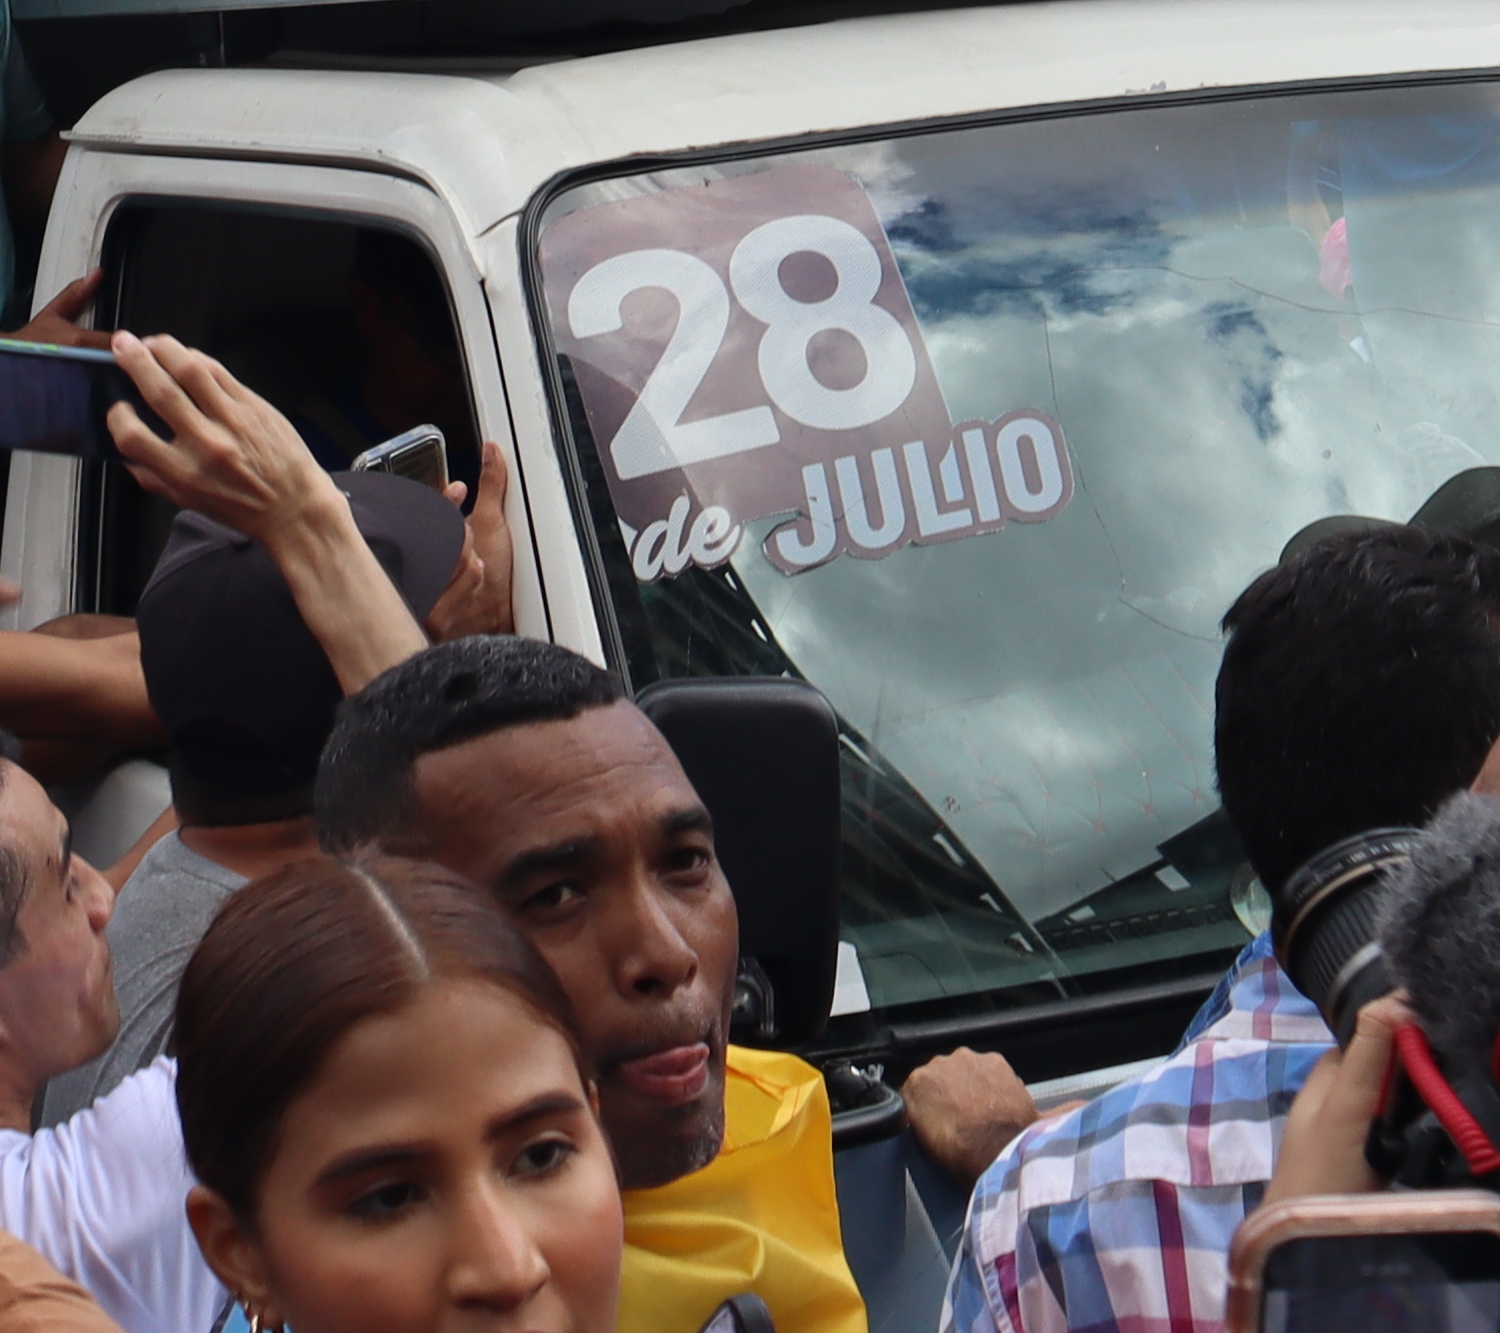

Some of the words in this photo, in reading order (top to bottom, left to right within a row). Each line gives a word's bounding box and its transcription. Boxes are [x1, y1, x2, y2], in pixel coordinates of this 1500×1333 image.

[567, 214, 917, 481] 28
[631, 493, 742, 579] de
[770, 417, 1064, 566] JULIO
